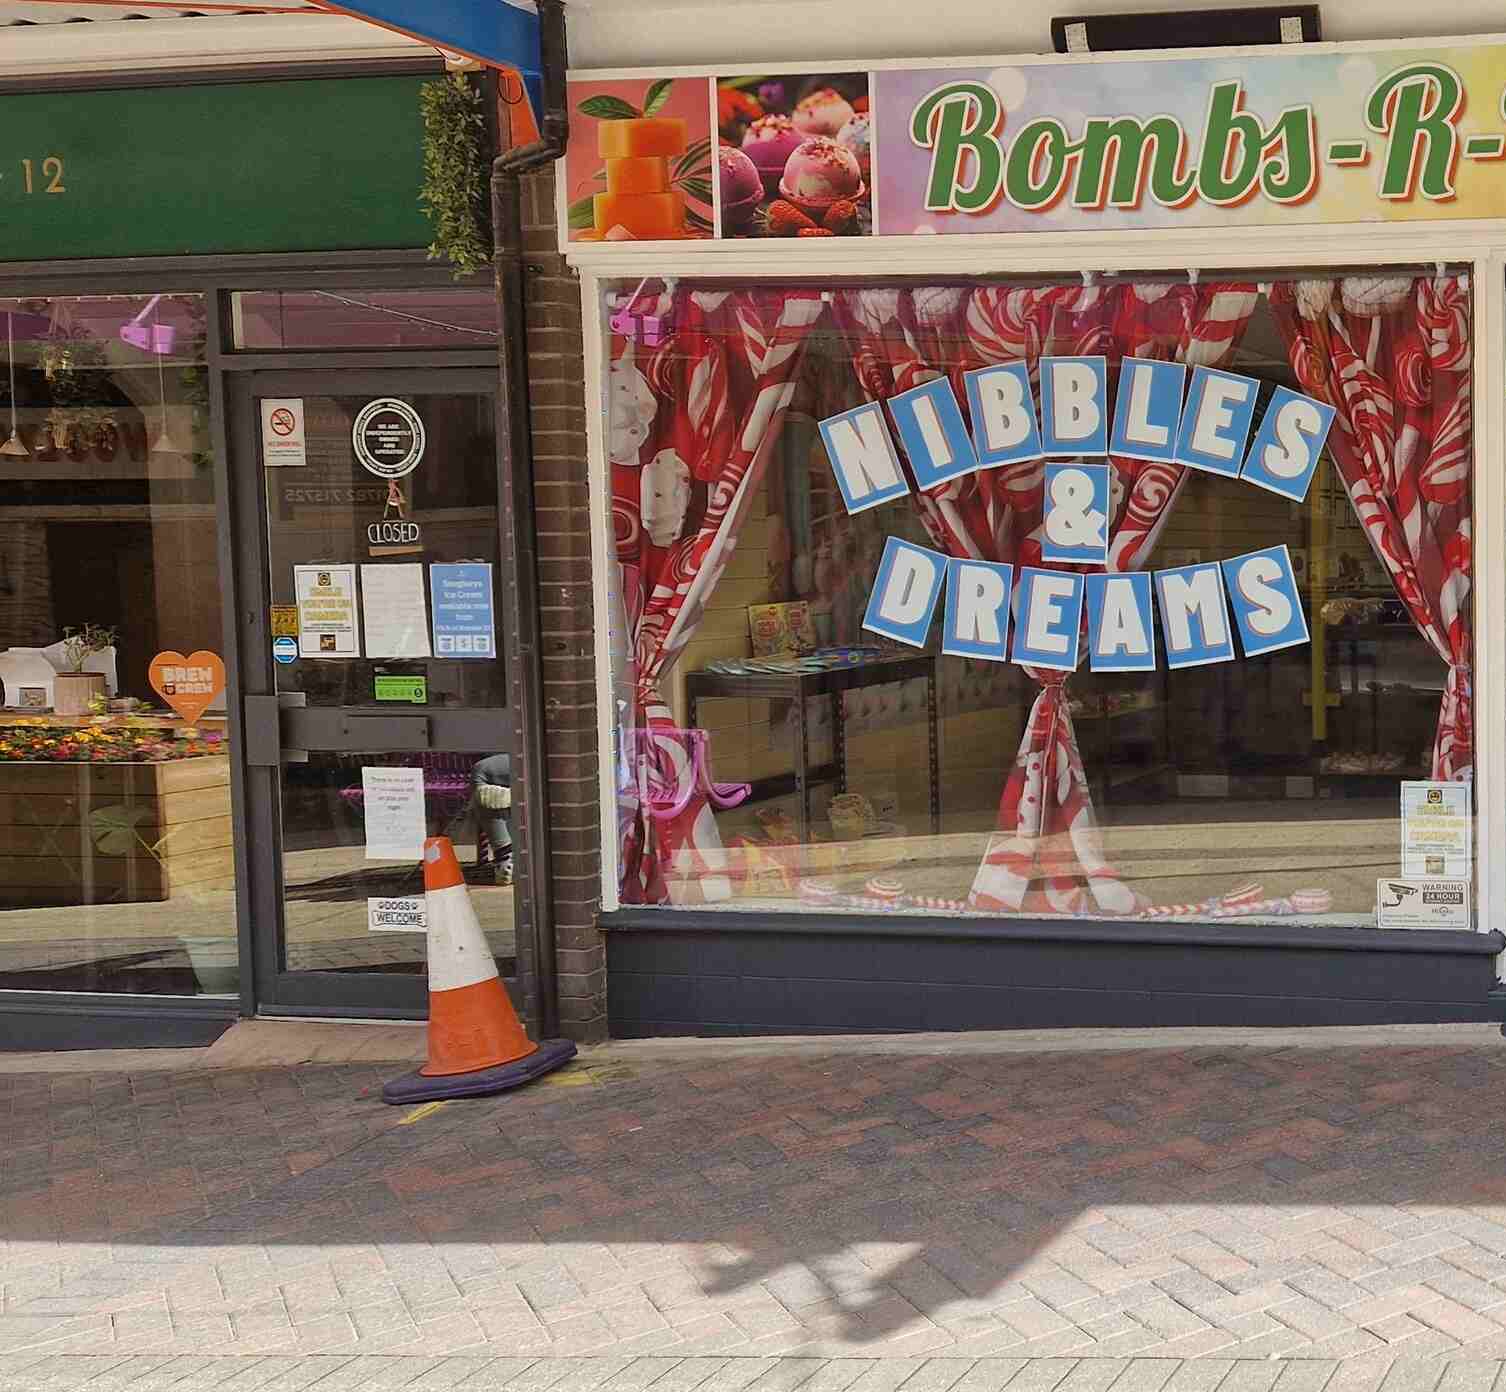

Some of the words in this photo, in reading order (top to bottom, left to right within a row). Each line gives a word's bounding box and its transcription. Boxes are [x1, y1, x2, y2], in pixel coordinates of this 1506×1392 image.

[22, 157, 65, 194] 12
[827, 361, 1322, 501] NIBBLES
[1045, 468, 1106, 547] &
[367, 522, 420, 544] CLOSED
[877, 545, 1293, 655] DREAMS
[161, 666, 213, 682] BREW
[1422, 883, 1464, 892] WARNING
[1425, 892, 1437, 900] 24
[1438, 892, 1461, 900] HOUR
[385, 901, 410, 911] DOGS
[376, 911, 423, 923] WELCOME
